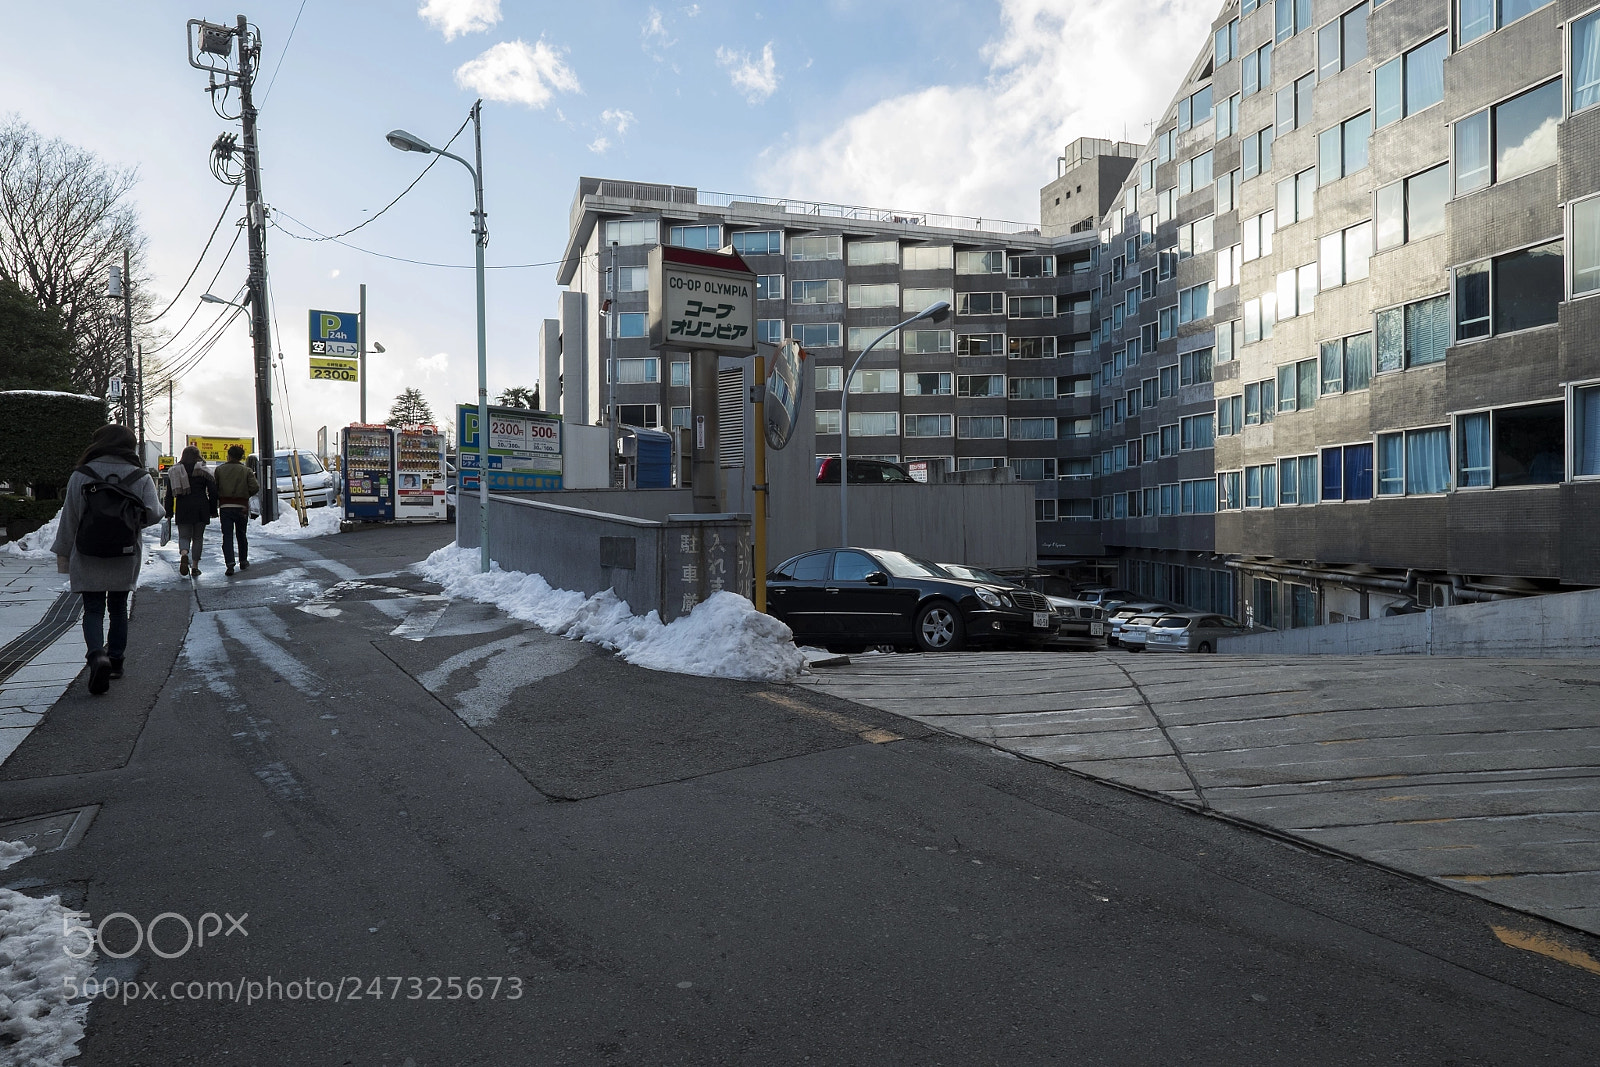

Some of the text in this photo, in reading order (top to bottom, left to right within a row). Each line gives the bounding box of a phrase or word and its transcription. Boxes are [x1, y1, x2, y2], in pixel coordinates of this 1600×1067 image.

[669, 277, 748, 298] CO-OP OLYMPIA
[684, 300, 736, 319] コープ
[320, 313, 341, 339] P
[670, 319, 748, 341] オリンピア
[329, 331, 347, 340] 24h
[312, 341, 326, 353] 空
[327, 344, 345, 354] 入口
[314, 369, 356, 381] 2300円
[492, 422, 524, 436] 2300円
[531, 426, 557, 438] 500円
